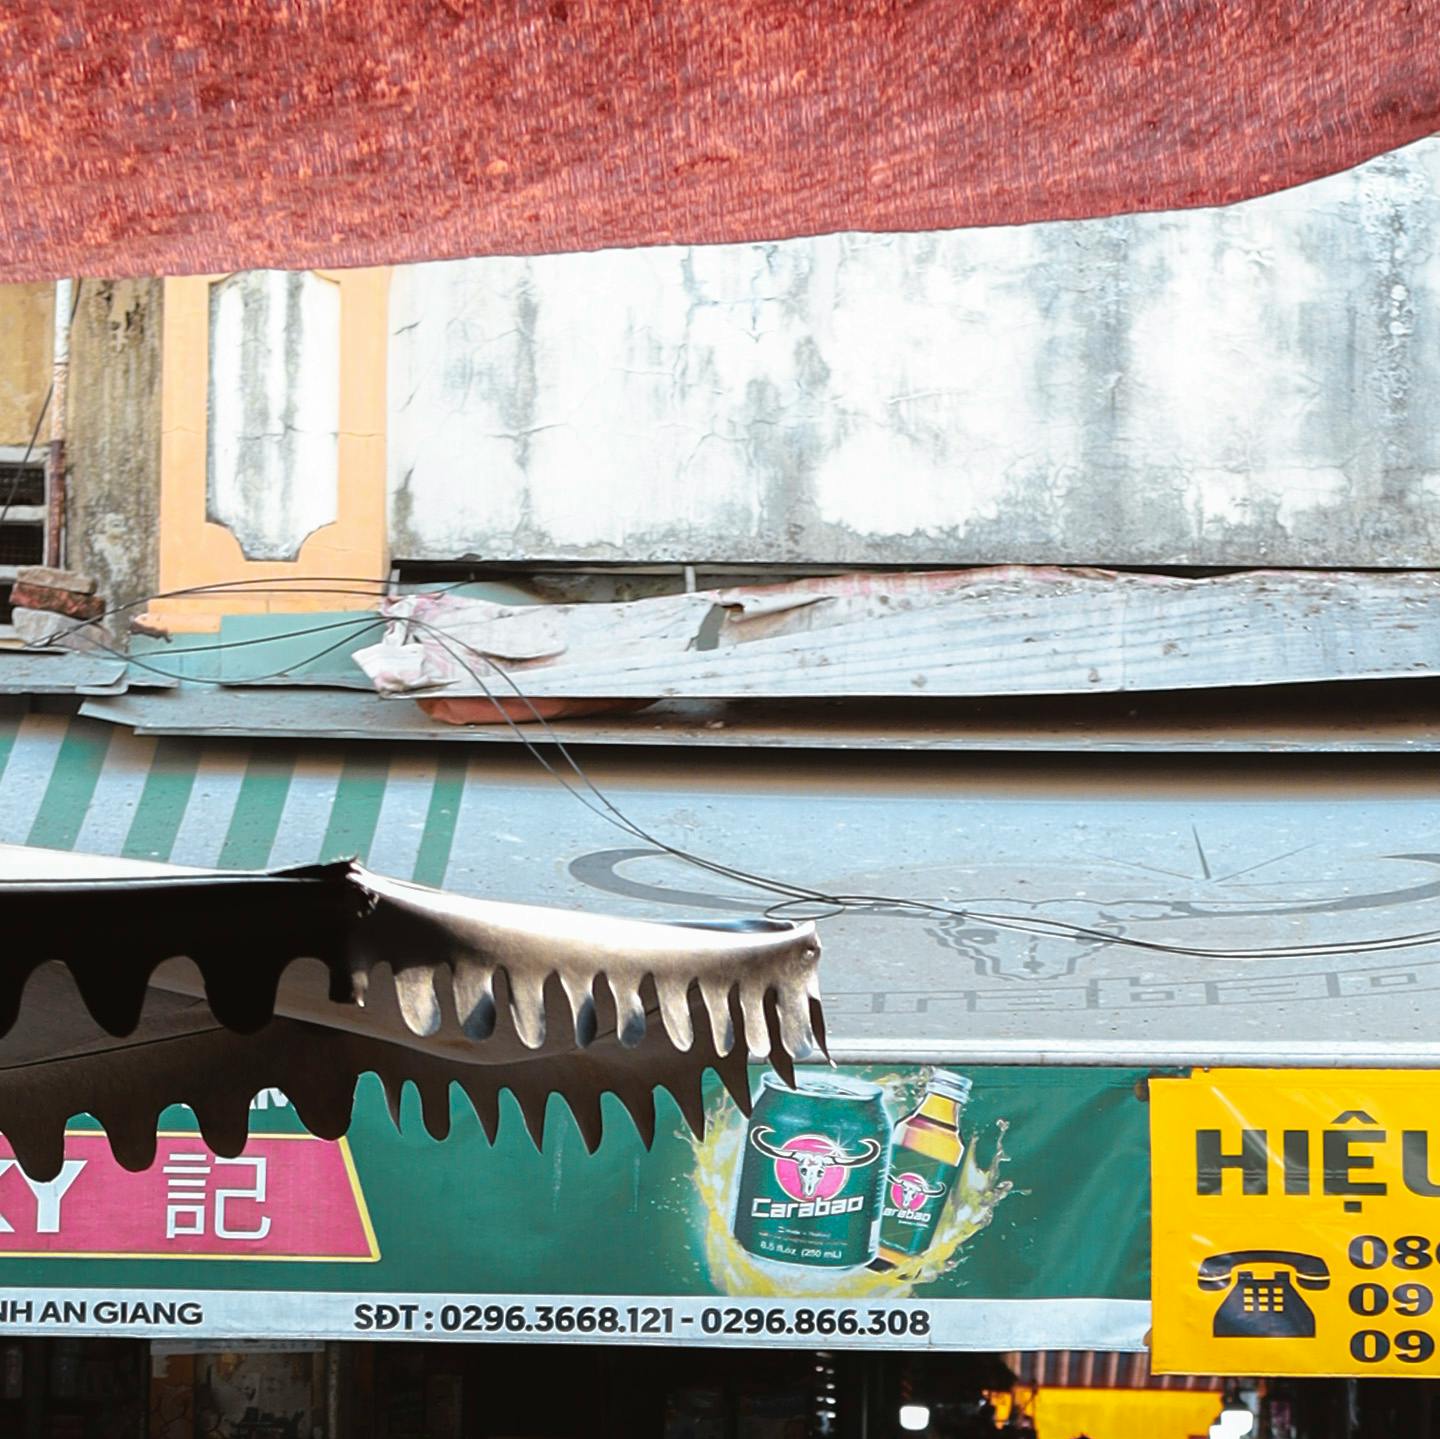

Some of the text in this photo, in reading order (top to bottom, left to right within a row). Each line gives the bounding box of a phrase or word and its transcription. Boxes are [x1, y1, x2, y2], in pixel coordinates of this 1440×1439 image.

[0, 1152, 272, 1241] Y 記
[751, 1196, 865, 1218] Carabao
[883, 1207, 932, 1223] arabao
[38, 1301, 86, 1323] AN
[93, 1301, 204, 1326] GIANG
[440, 1304, 674, 1333] 0296.3668.121
[701, 1307, 931, 1335] 0296.866.308
